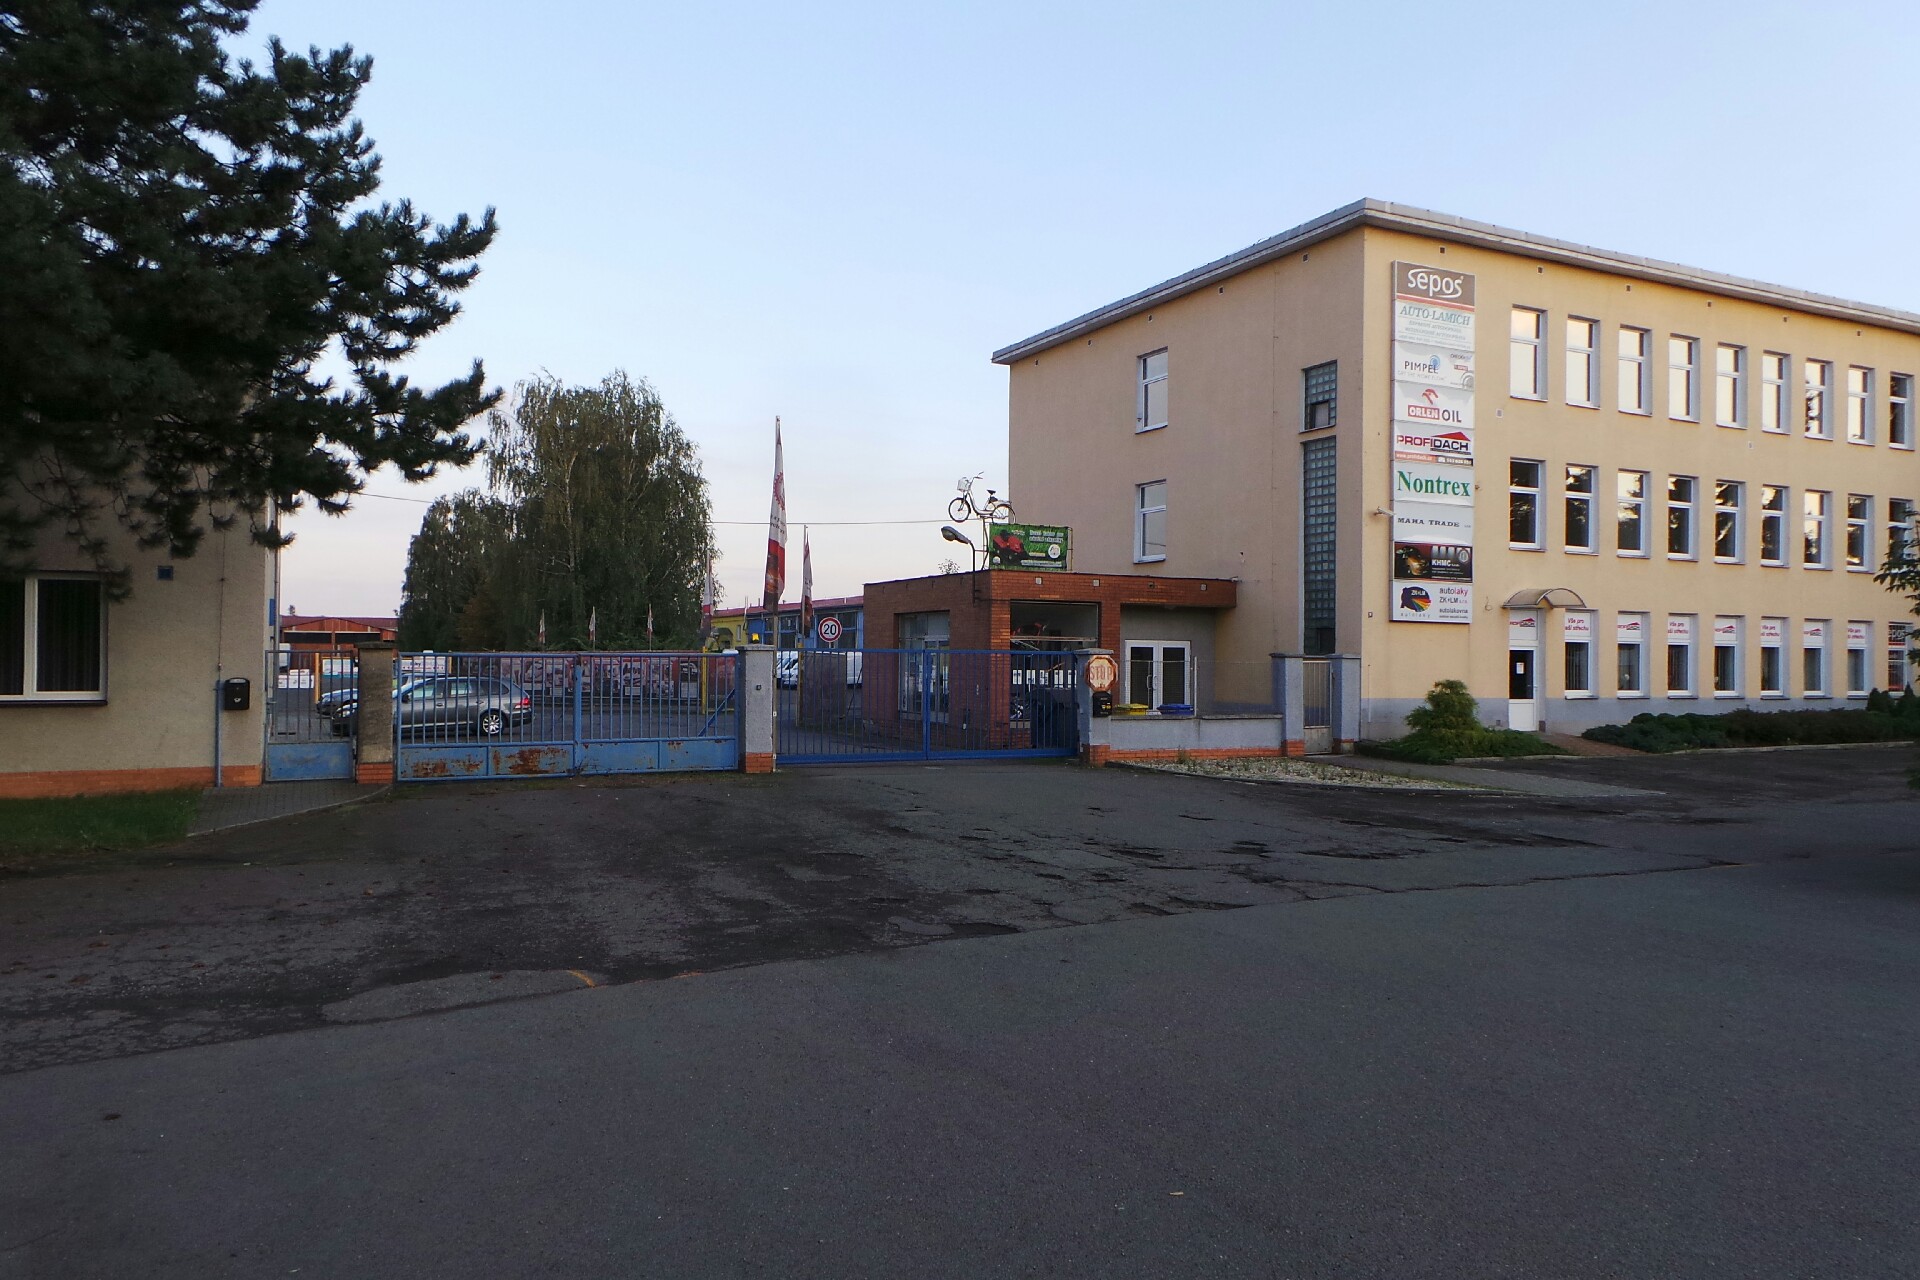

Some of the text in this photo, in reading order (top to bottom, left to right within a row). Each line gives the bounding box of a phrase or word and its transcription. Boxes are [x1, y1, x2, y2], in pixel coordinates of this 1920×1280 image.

[1408, 268, 1463, 298] sepos
[1400, 305, 1470, 326] AUTO-LAMICH
[1404, 360, 1439, 374] PIMPEL
[1408, 406, 1462, 423] ORLEN OIL
[1396, 434, 1469, 451] PROFIDACH
[1397, 471, 1471, 497] Nontrex
[1397, 517, 1425, 525] MAHA
[1428, 519, 1460, 528] TRADE
[1431, 559, 1452, 567] KHMC
[1439, 587, 1469, 597] autolaky
[823, 623, 837, 635] 20
[1090, 665, 1112, 680] STOP
